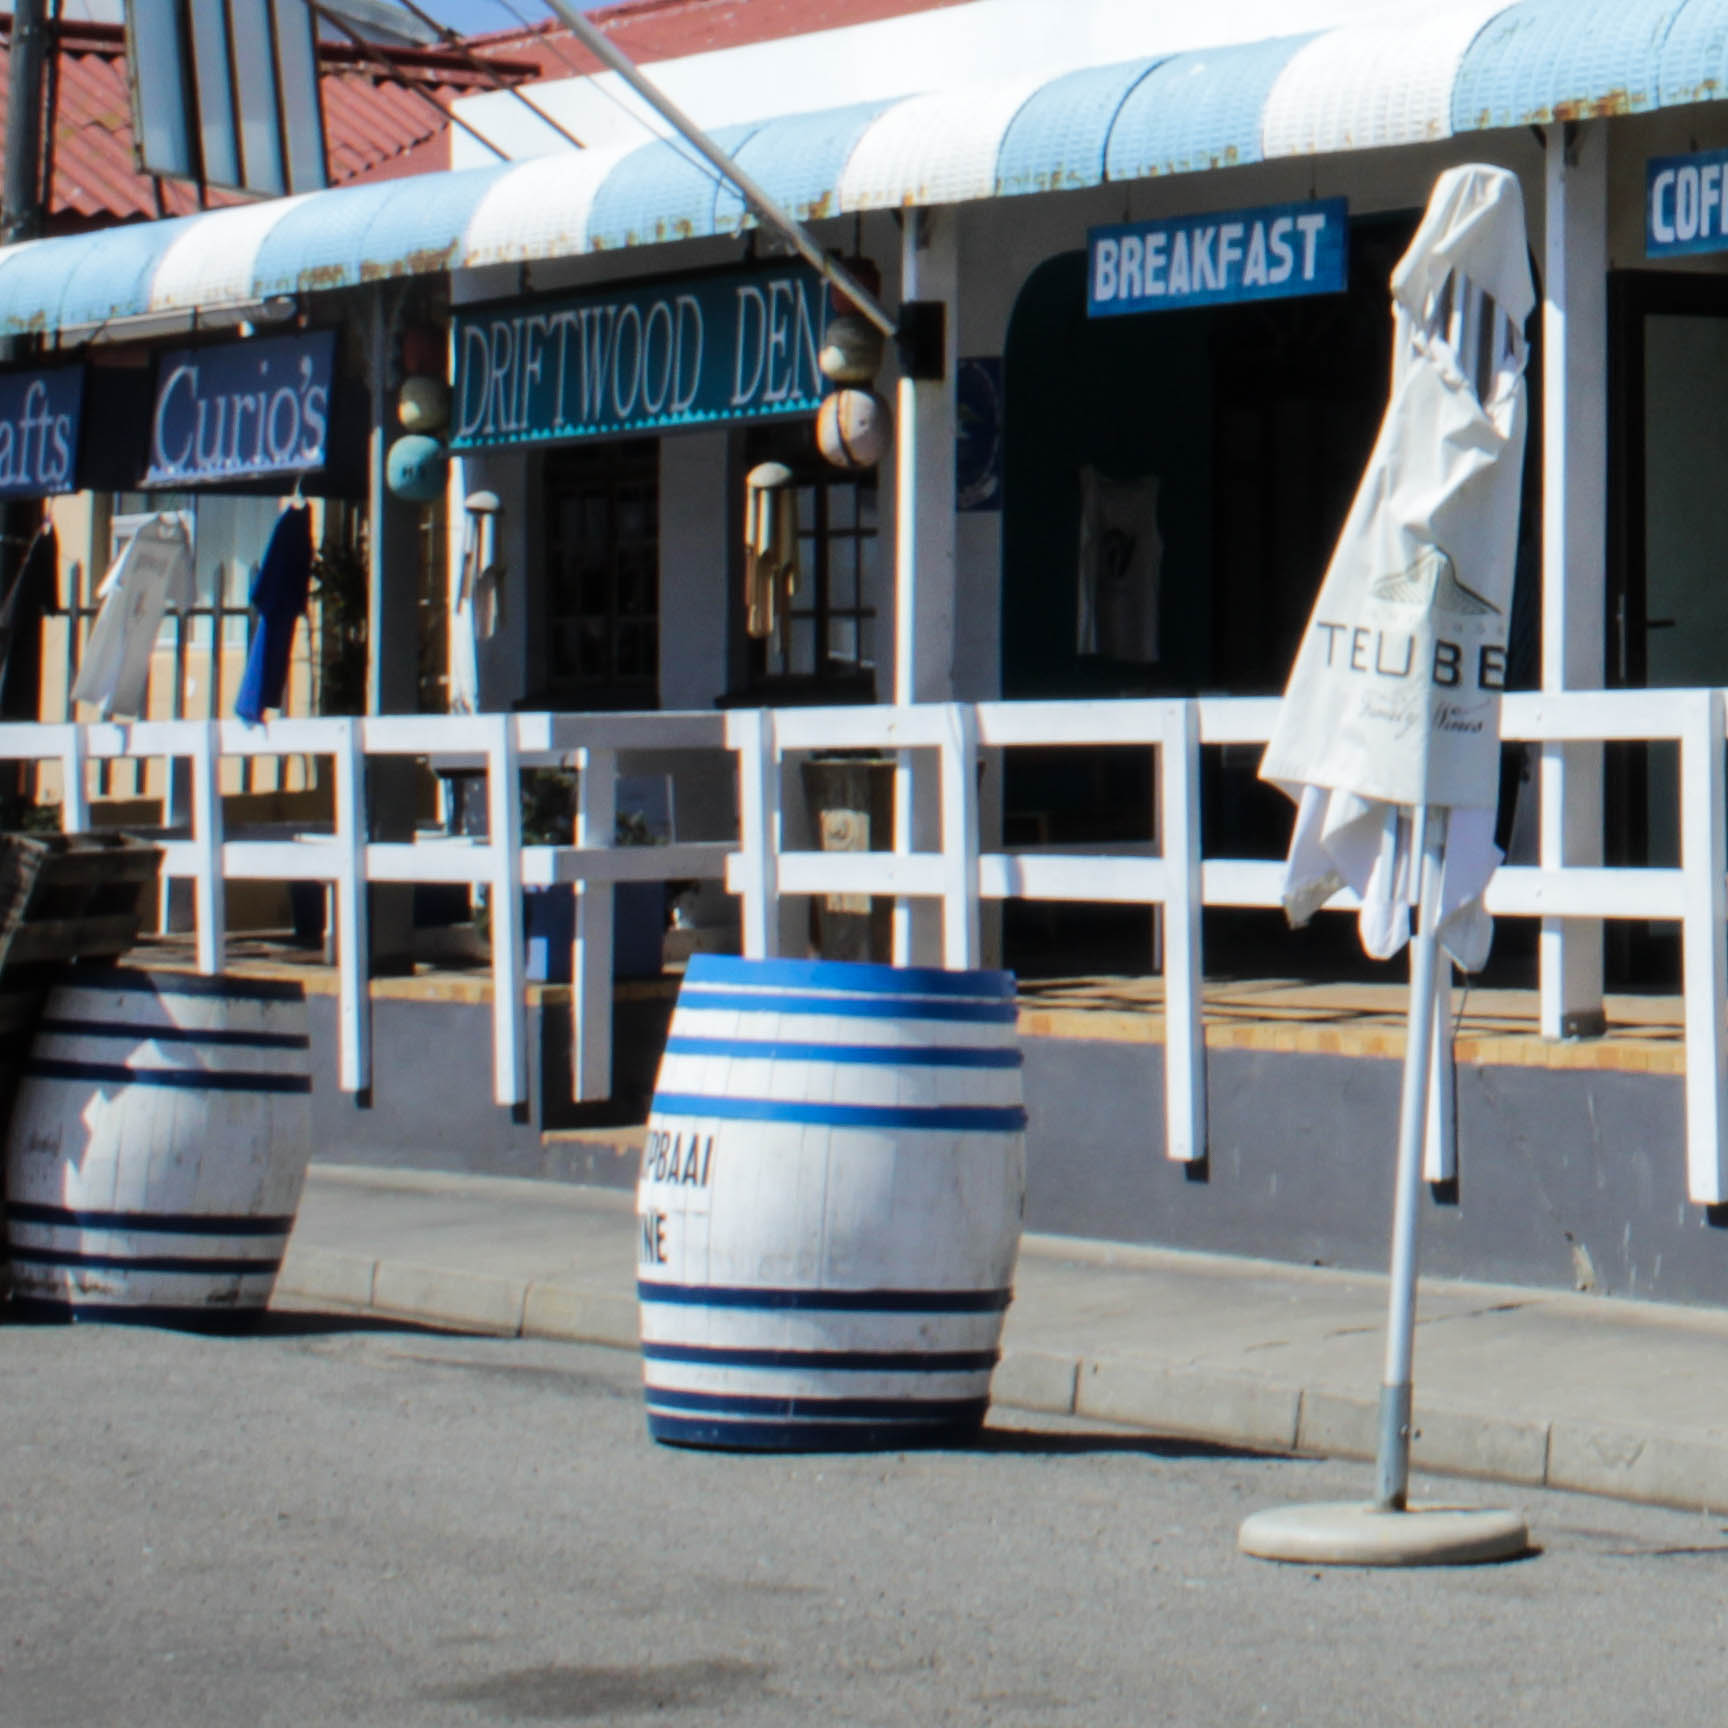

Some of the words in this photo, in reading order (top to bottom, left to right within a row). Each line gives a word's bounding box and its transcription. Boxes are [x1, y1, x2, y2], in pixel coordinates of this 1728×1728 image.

[1092, 213, 1328, 304] BREAKFAST
[153, 354, 329, 470] Curio's
[457, 293, 705, 438] DRIFTWOOD
[731, 278, 830, 407] DEN
